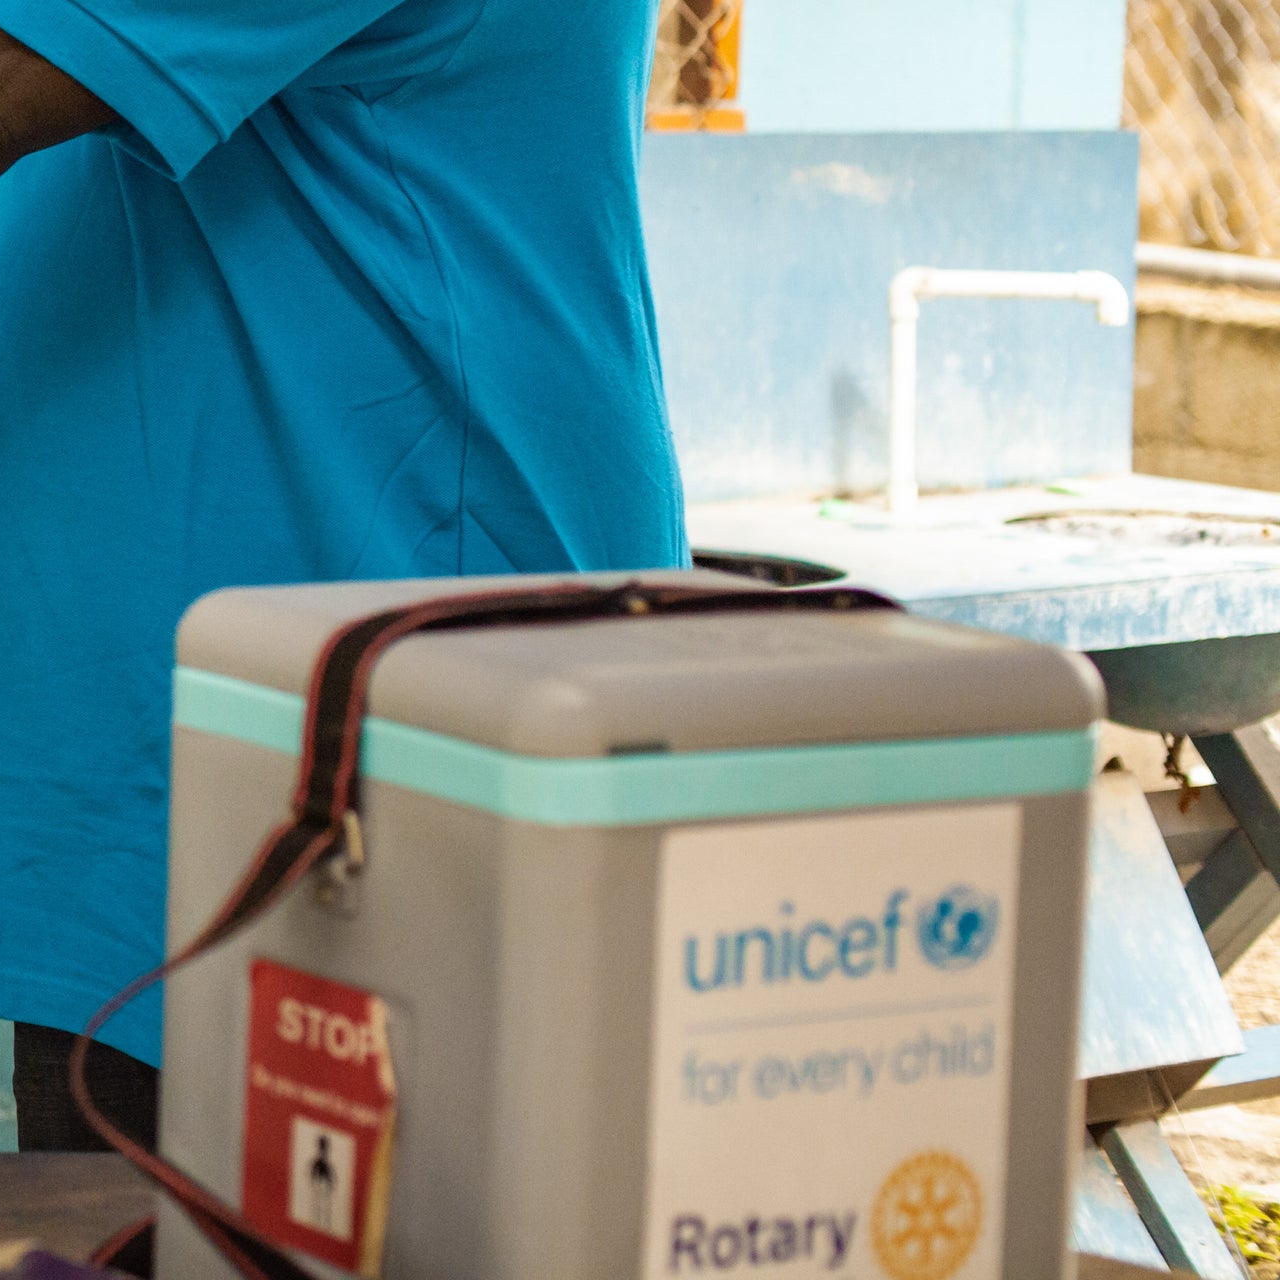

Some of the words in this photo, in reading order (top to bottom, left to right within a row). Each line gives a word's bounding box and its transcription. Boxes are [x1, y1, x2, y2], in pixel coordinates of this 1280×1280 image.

[683, 887, 912, 993] unicef
[275, 996, 378, 1066] STOP
[681, 1046, 744, 1106] for
[752, 1046, 885, 1099] every
[891, 1021, 997, 1085] child
[668, 1208, 859, 1272] Rotary
